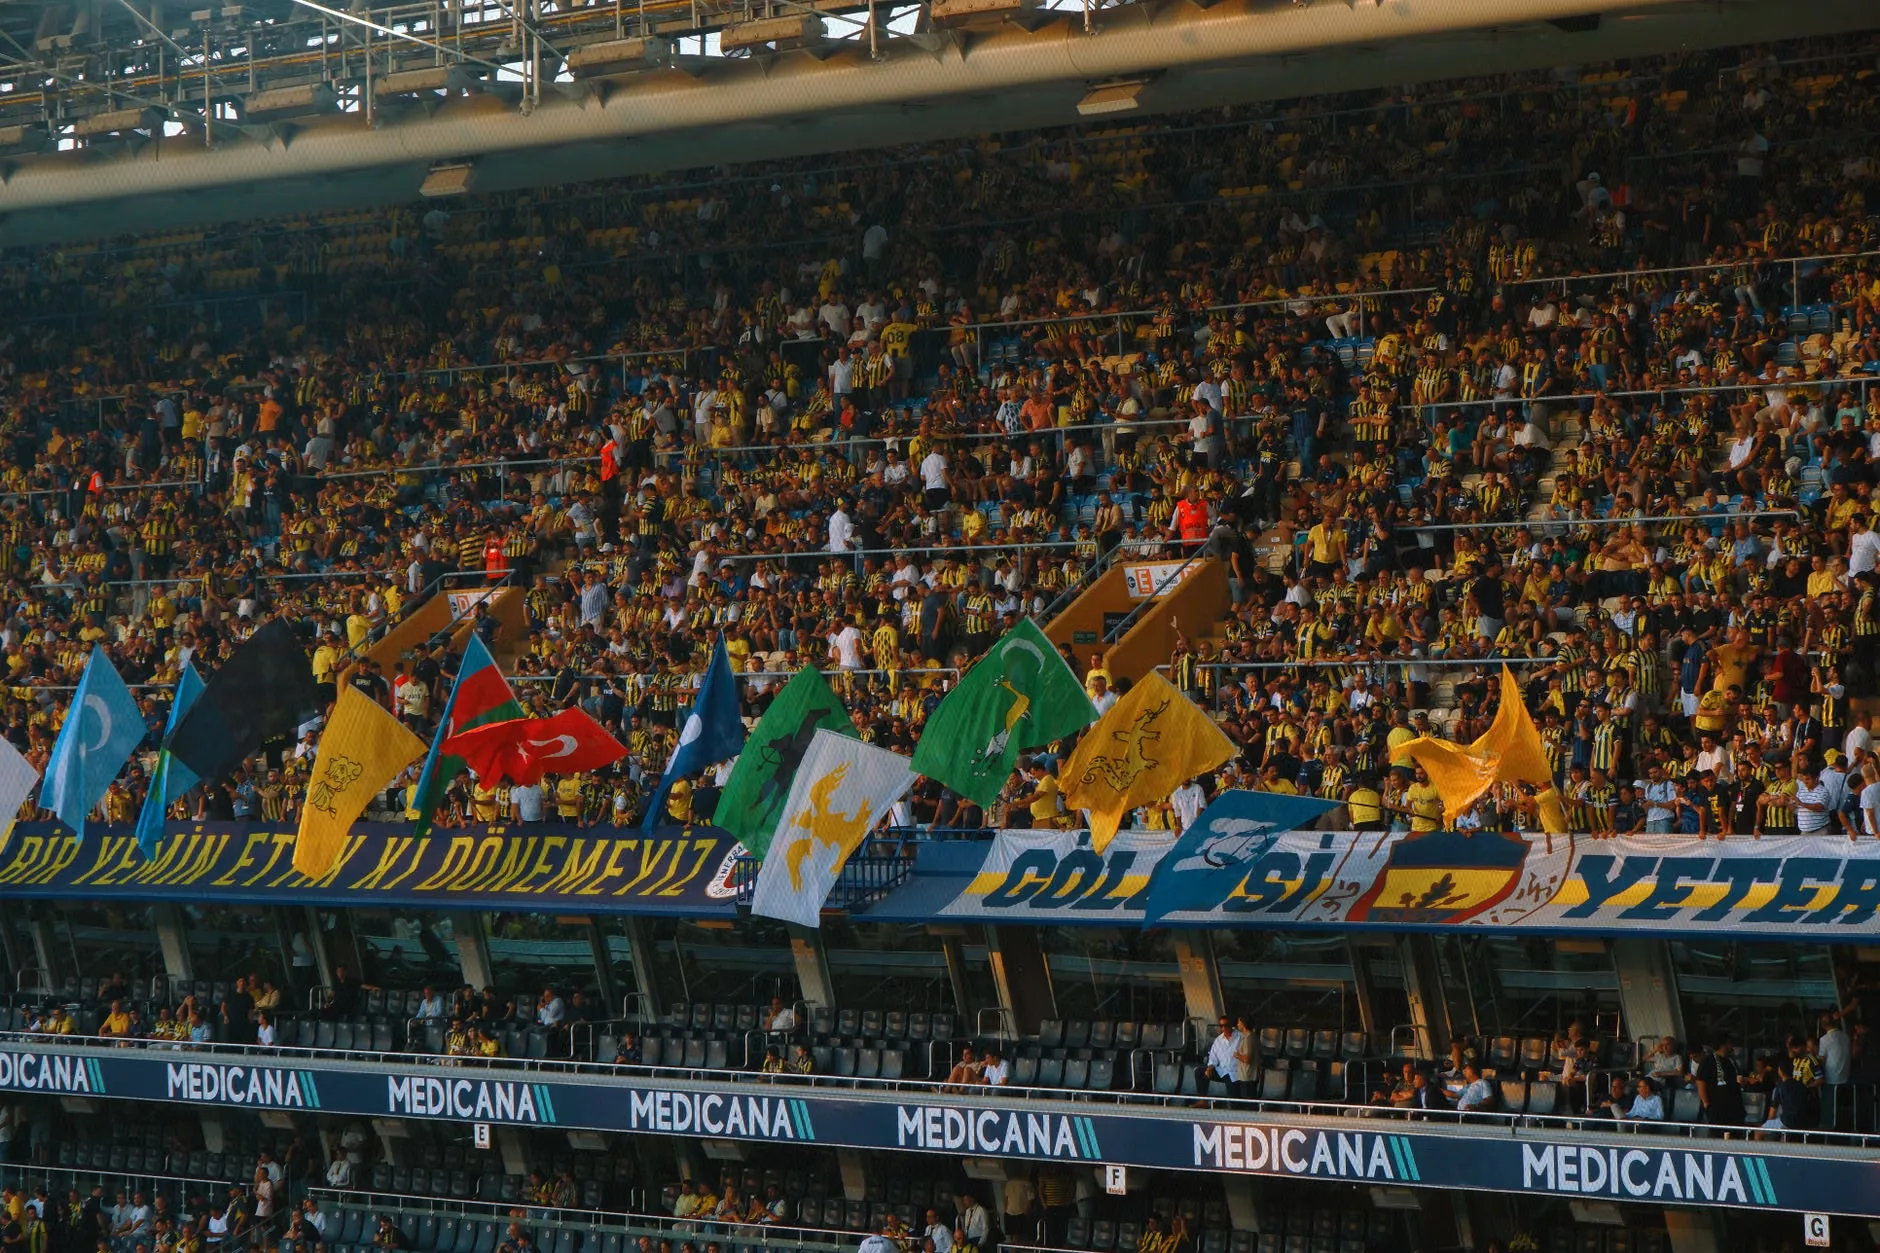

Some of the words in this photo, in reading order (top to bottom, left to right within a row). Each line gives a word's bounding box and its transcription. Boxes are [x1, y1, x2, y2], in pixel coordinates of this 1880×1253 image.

[887, 330, 905, 345] 08
[1139, 570, 1151, 589] E
[0, 828, 84, 884] BİR
[412, 827, 718, 897] DÖNEMEYİZ
[168, 1063, 303, 1107] MEDICANA
[388, 1075, 537, 1122] MEDICANA
[630, 1090, 794, 1139] MEDICANA
[897, 1105, 1077, 1158] MEDICANA
[1193, 1123, 1394, 1179] MEDICANA
[1522, 1143, 1748, 1203] MEDICANA
[1811, 1217, 1824, 1238] G
